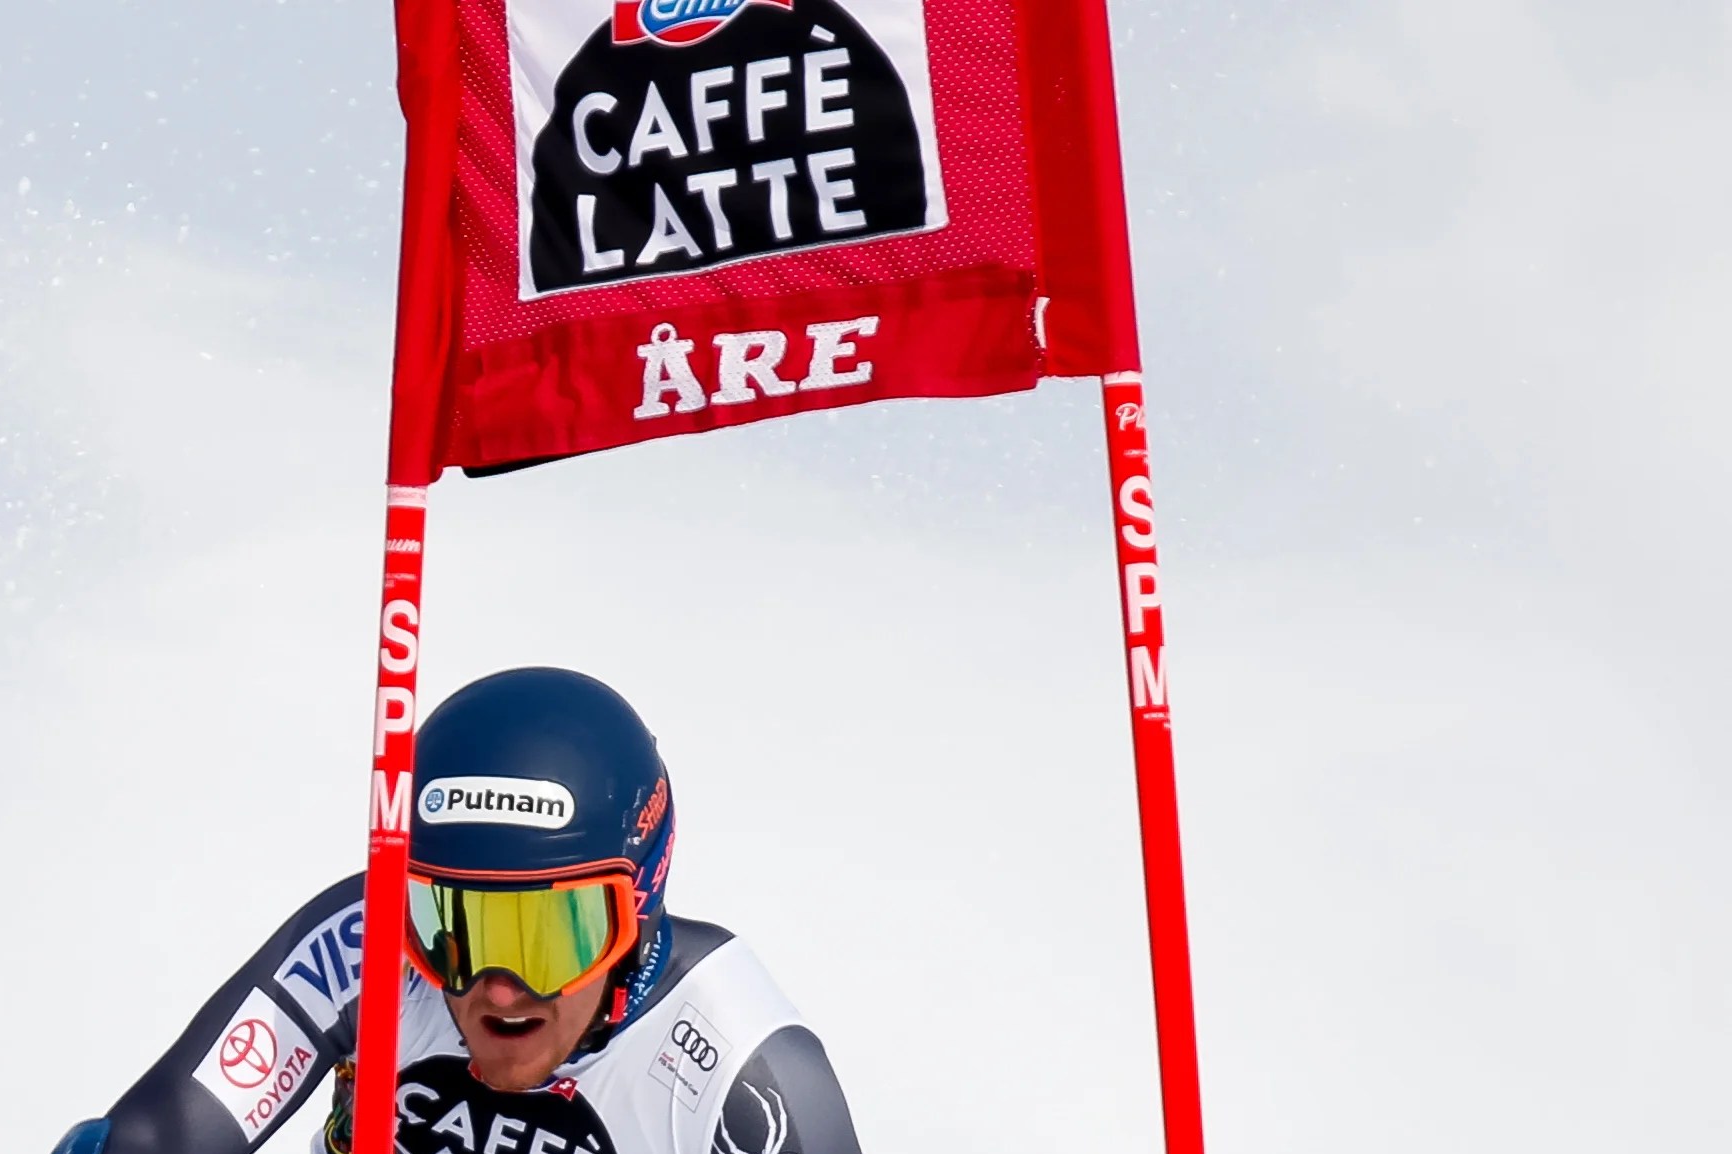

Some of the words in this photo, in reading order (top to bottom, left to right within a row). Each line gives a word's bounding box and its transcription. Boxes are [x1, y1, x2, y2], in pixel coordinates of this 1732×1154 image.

[572, 24, 855, 174] CAFFÈ
[576, 148, 869, 275] LATTE
[632, 315, 880, 421] ÅRE
[1119, 475, 1169, 707] SPM
[370, 599, 419, 832] SPM
[446, 788, 566, 818] Putnam
[244, 1045, 313, 1130] TOYOTA
